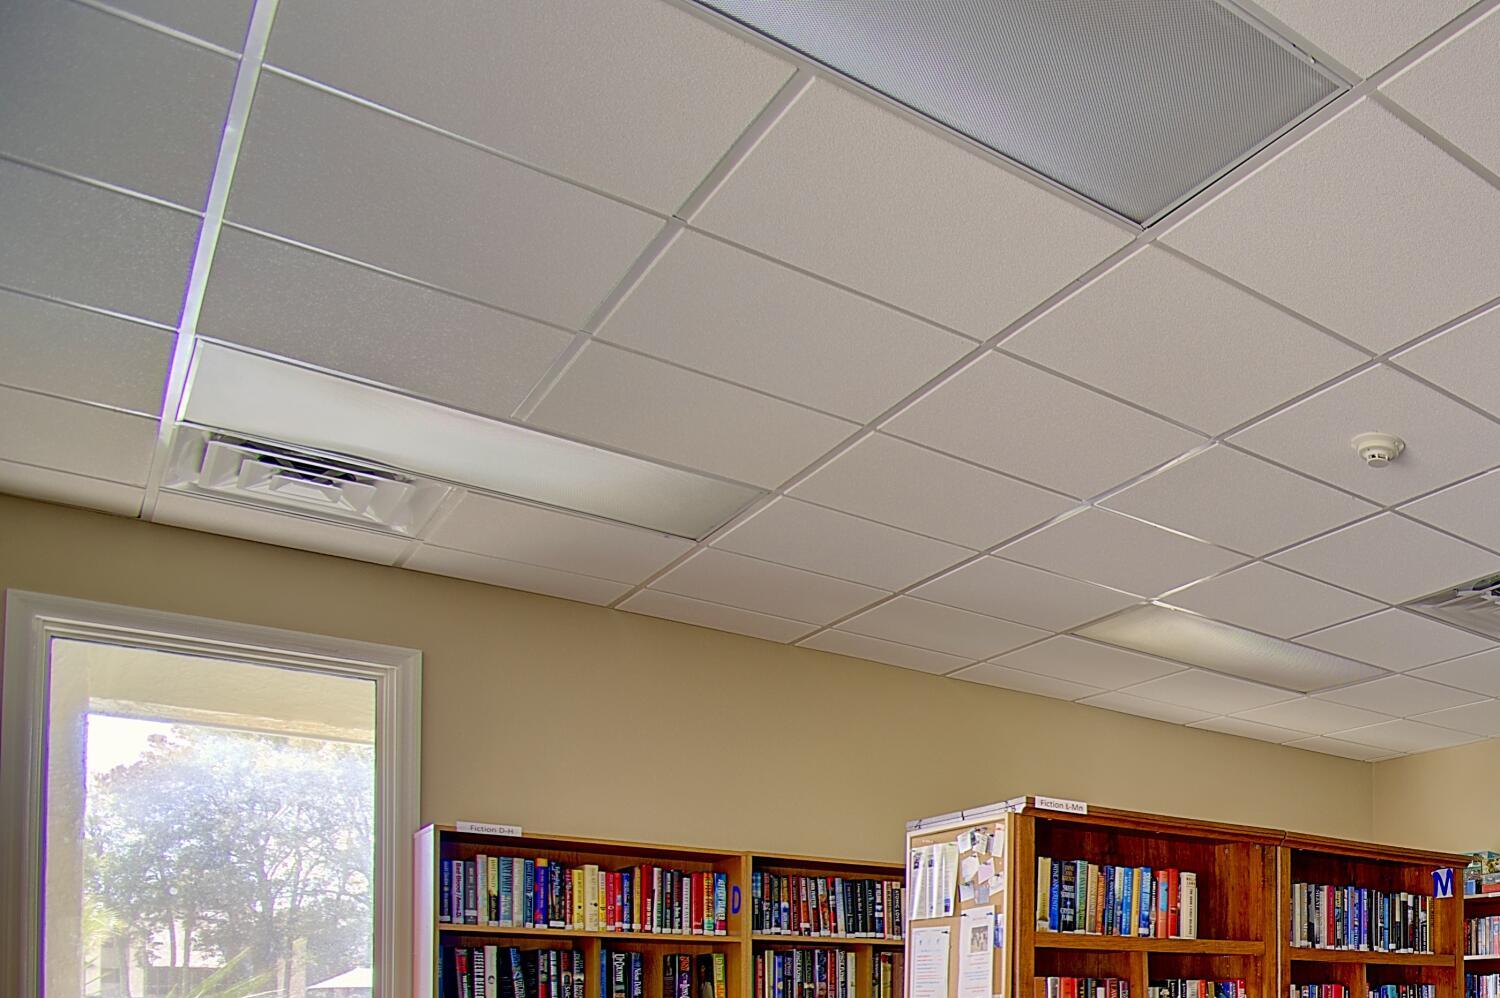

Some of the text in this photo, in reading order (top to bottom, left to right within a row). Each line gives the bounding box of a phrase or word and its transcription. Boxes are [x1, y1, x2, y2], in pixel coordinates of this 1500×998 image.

[1040, 799, 1083, 812] Fiction L-Mn
[470, 824, 497, 833] Fiction
[1433, 868, 1453, 898] M
[731, 885, 741, 914] D
[474, 951, 485, 976] JEFFERY
[1303, 989, 1310, 997] Ed
